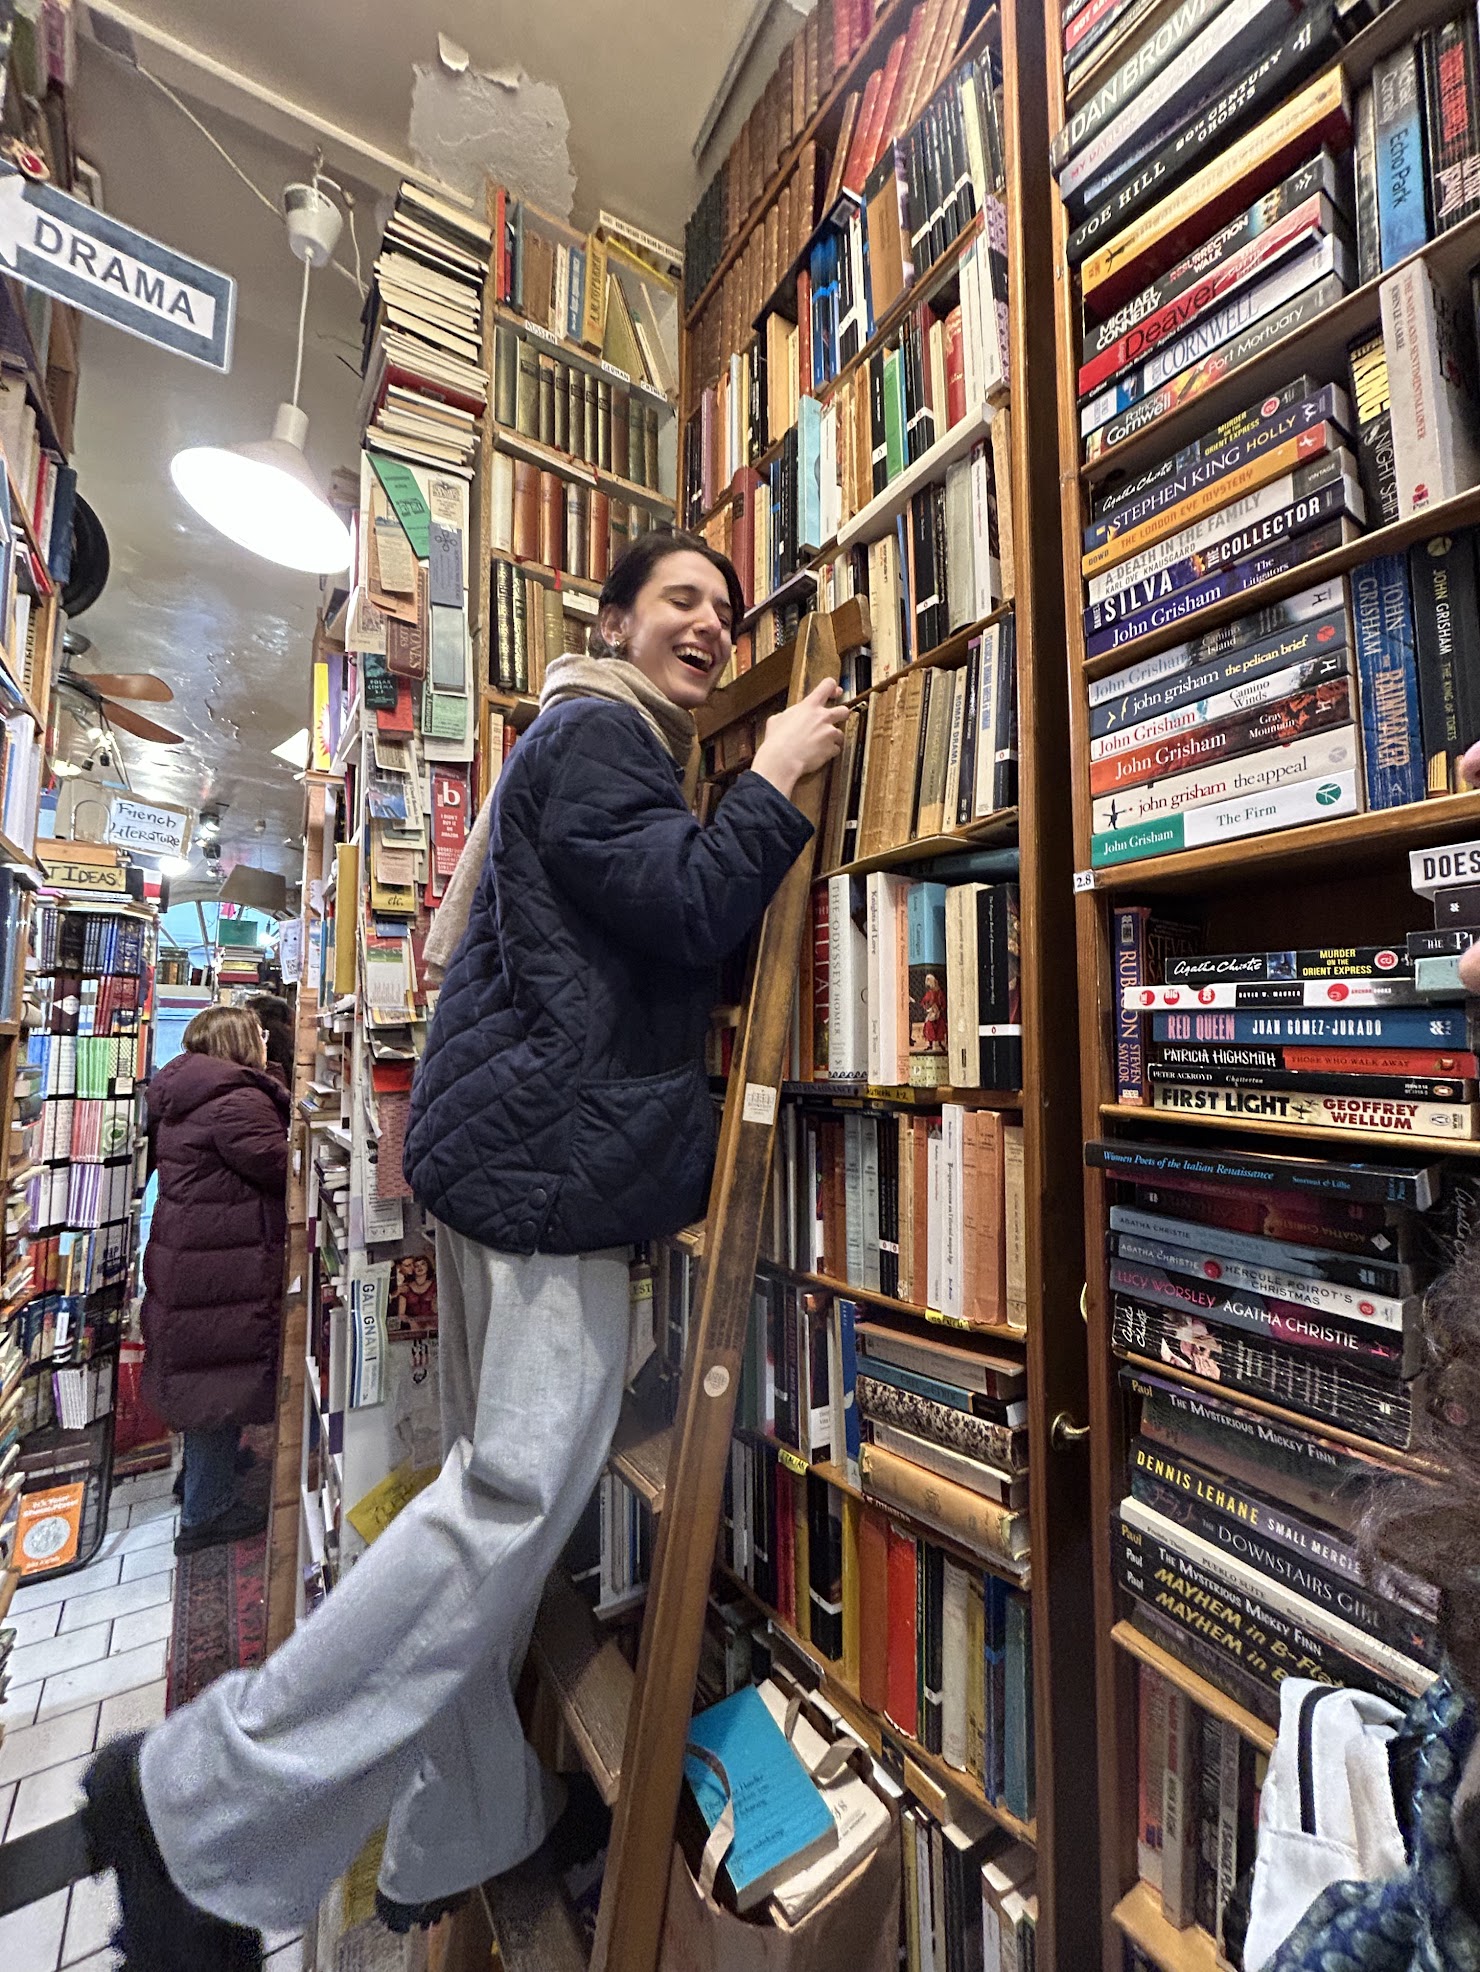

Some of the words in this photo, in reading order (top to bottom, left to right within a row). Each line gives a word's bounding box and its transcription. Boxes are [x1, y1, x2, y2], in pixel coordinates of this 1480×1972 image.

[1208, 47, 1283, 121] CENTURY
[1071, 84, 1119, 145] DAN
[1197, 84, 1256, 142] GHOSTS
[1389, 127, 1408, 168] Echo
[1076, 204, 1112, 246] JOE
[1118, 160, 1167, 210] HILL
[1392, 166, 1412, 210] Park
[1168, 214, 1250, 283] RESURRECTION
[1193, 246, 1223, 274] WALK
[34, 215, 196, 325] DRAMA
[1096, 291, 1162, 351] CONNELLY
[1099, 284, 1159, 336] MICHAEL
[1123, 277, 1219, 361] Deaver
[1160, 290, 1261, 376] CORNWELL
[1208, 349, 1234, 375] Port
[1237, 305, 1304, 358] Mortuary
[1106, 392, 1171, 445] Cornwell
[1204, 438, 1228, 456] ORIENT
[1229, 417, 1260, 443] EXPRESS
[1217, 411, 1247, 435] MURDER
[1112, 475, 1188, 531] STEPHEN
[1191, 445, 1241, 488] KING
[1246, 414, 1297, 454] HOLLY
[1307, 463, 1336, 482] VINTAGE
[1374, 430, 1396, 483] NIGHT
[1102, 484, 1137, 512] Agatha
[1136, 458, 1173, 491] Christie
[1120, 537, 1137, 549] THE
[1139, 511, 1178, 538] LONDON
[1180, 501, 1198, 515] EYE
[1202, 468, 1254, 505] MYSTERY
[1105, 571, 1115, 586] A
[1116, 546, 1157, 577] DEATH
[1160, 538, 1175, 555] IN
[1176, 522, 1204, 548] THE
[1206, 490, 1263, 534] FAMILY
[1206, 546, 1220, 569] THE
[1220, 494, 1321, 561] COLLECTOR
[1104, 581, 1123, 596] KARL
[1124, 572, 1140, 587] OVE
[1142, 541, 1197, 576] KNAUSGAARD
[1242, 561, 1290, 590] Litigators
[1254, 557, 1275, 572] The
[1103, 568, 1174, 624] SILVA
[1112, 618, 1148, 648] John
[1151, 582, 1222, 631] Grisham
[1383, 581, 1406, 632] JOHN
[1201, 624, 1242, 647] Camino
[1358, 577, 1382, 657] GRISHAM
[1206, 635, 1238, 656] Island
[1093, 678, 1126, 702] John
[1128, 651, 1186, 688] Grisham
[1132, 692, 1162, 716] john
[1164, 668, 1220, 705] grisham
[1224, 662, 1242, 677] the
[1242, 650, 1280, 673] pelican
[1280, 633, 1309, 656] brief
[1228, 679, 1271, 699] Camino
[424, 695, 434, 733] Seminary
[951, 693, 963, 730] ROMAN
[1233, 690, 1269, 709] Winds
[1258, 711, 1284, 727] Gray
[1375, 668, 1410, 769] RAINMAKER
[950, 730, 961, 766] DRAMA
[1098, 733, 1131, 757] John
[1133, 708, 1197, 743] Grisham
[1248, 717, 1297, 741] Mountain
[1114, 755, 1152, 781] John
[1154, 731, 1227, 767] Grisham
[442, 781, 461, 806] b
[1138, 790, 1168, 816] john
[1170, 777, 1227, 810] grisham
[1233, 771, 1256, 790] the
[1256, 754, 1309, 785] appeal
[1216, 810, 1242, 828] The
[1244, 803, 1278, 823] Firm
[1103, 838, 1128, 857] John
[1128, 827, 1175, 848] Grisham
[387, 896, 404, 907] etc.
[832, 885, 841, 916] THE
[1076, 874, 1092, 888] 2.8
[870, 889, 879, 919] Knights
[831, 918, 842, 987] ODYSSEY
[1173, 960, 1216, 977] Agatha
[1216, 956, 1263, 973] Christie
[1302, 966, 1332, 977] ORIENT
[1333, 965, 1373, 976] EXPRESS
[1319, 949, 1356, 959] MURDER
[832, 992, 841, 1036] HOMER
[1167, 1014, 1191, 1040] RED
[1195, 1014, 1236, 1041] QUEEN
[1252, 1019, 1281, 1036] JUAN
[1118, 1042, 1129, 1083] SAYLOR
[1129, 1044, 1141, 1084] STEVEN
[1153, 1070, 1176, 1079] PETER
[1176, 1071, 1213, 1081] ACKROYD
[1225, 1074, 1264, 1085] Chatterton
[1163, 1048, 1210, 1064] PATRICIA
[1213, 1049, 1277, 1068] HIGHSMITH
[1291, 1056, 1323, 1064] THOSE
[1325, 1057, 1347, 1065] WHO
[1349, 1059, 1379, 1067] WALK
[1381, 1060, 1411, 1068] AWAY
[1162, 1088, 1220, 1110] FIRST
[1225, 1092, 1290, 1117] LIGHT
[1322, 1098, 1419, 1117] GEOFFREY
[1331, 1111, 1413, 1131] WELLUM
[1103, 1150, 1133, 1164] Women
[1134, 1154, 1156, 1167] Poets
[1156, 1157, 1169, 1170] of
[1168, 1158, 1182, 1170] the
[1183, 1159, 1214, 1173] Italian
[1216, 1163, 1275, 1181] Renaissance
[1119, 1217, 1151, 1231] AGATHA
[1153, 1224, 1191, 1239] CHRISTIE
[1120, 1243, 1155, 1258] AGATHA
[1156, 1249, 1200, 1270] CHRISTIE
[1225, 1263, 1283, 1288] HERCULE
[1287, 1279, 1354, 1304] POIROT'S
[1250, 1279, 1321, 1307] CHRISTMAS
[361, 1283, 378, 1363] GALIGNANI
[1117, 1269, 1150, 1289] LUCY
[1152, 1279, 1218, 1309] WORSLEY
[1223, 1299, 1283, 1330] AGATHA
[1285, 1316, 1360, 1351] CHRISTIE
[1131, 1379, 1153, 1398] Paul
[1136, 1449, 1192, 1491] DENNIS
[1197, 1479, 1259, 1526] LEHANE
[1266, 1517, 1308, 1548] SMALL
[1311, 1539, 1362, 1576] MERCIE
[1126, 1547, 1143, 1568] Paul
[1154, 1567, 1242, 1630] MAYHEM
[1245, 1624, 1267, 1645] in
[1217, 1524, 1332, 1602] DOWNSTAIRS
[1337, 1591, 1380, 1629] GIRL
